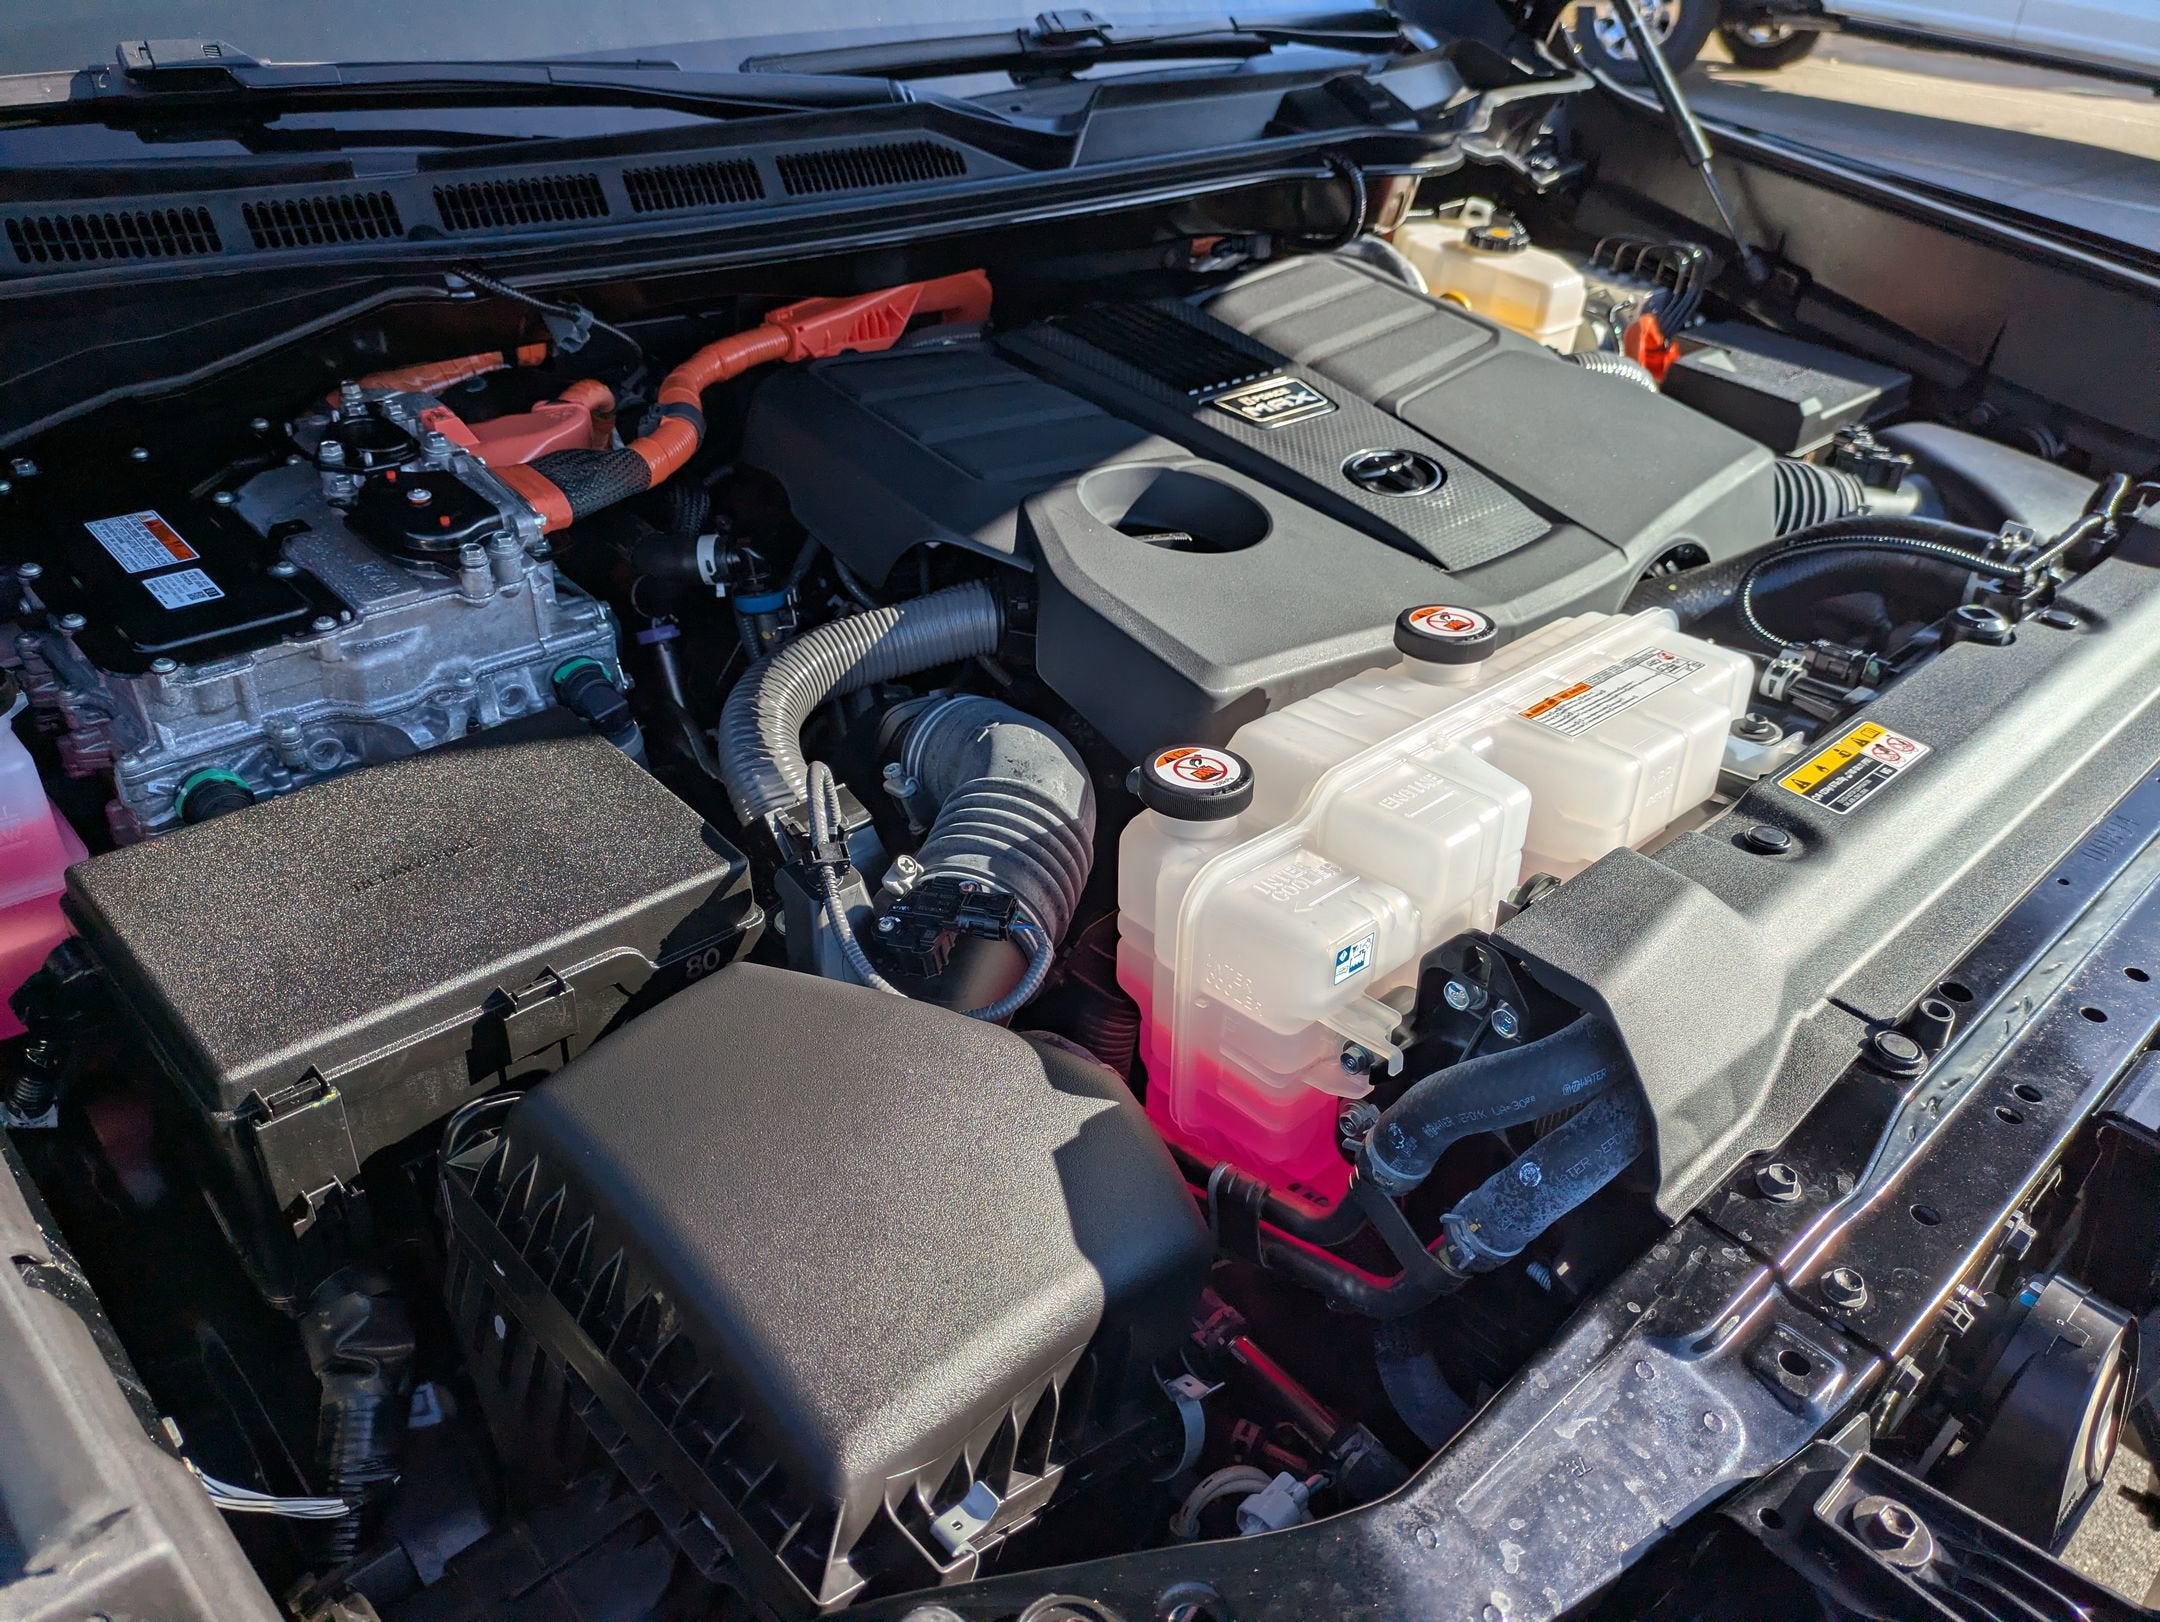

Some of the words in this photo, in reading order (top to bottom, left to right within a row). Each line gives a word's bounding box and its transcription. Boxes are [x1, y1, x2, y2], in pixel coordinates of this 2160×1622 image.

[1241, 390, 1318, 417] MAX
[1378, 773, 1445, 810] ENGINE
[686, 946, 721, 979] 80
